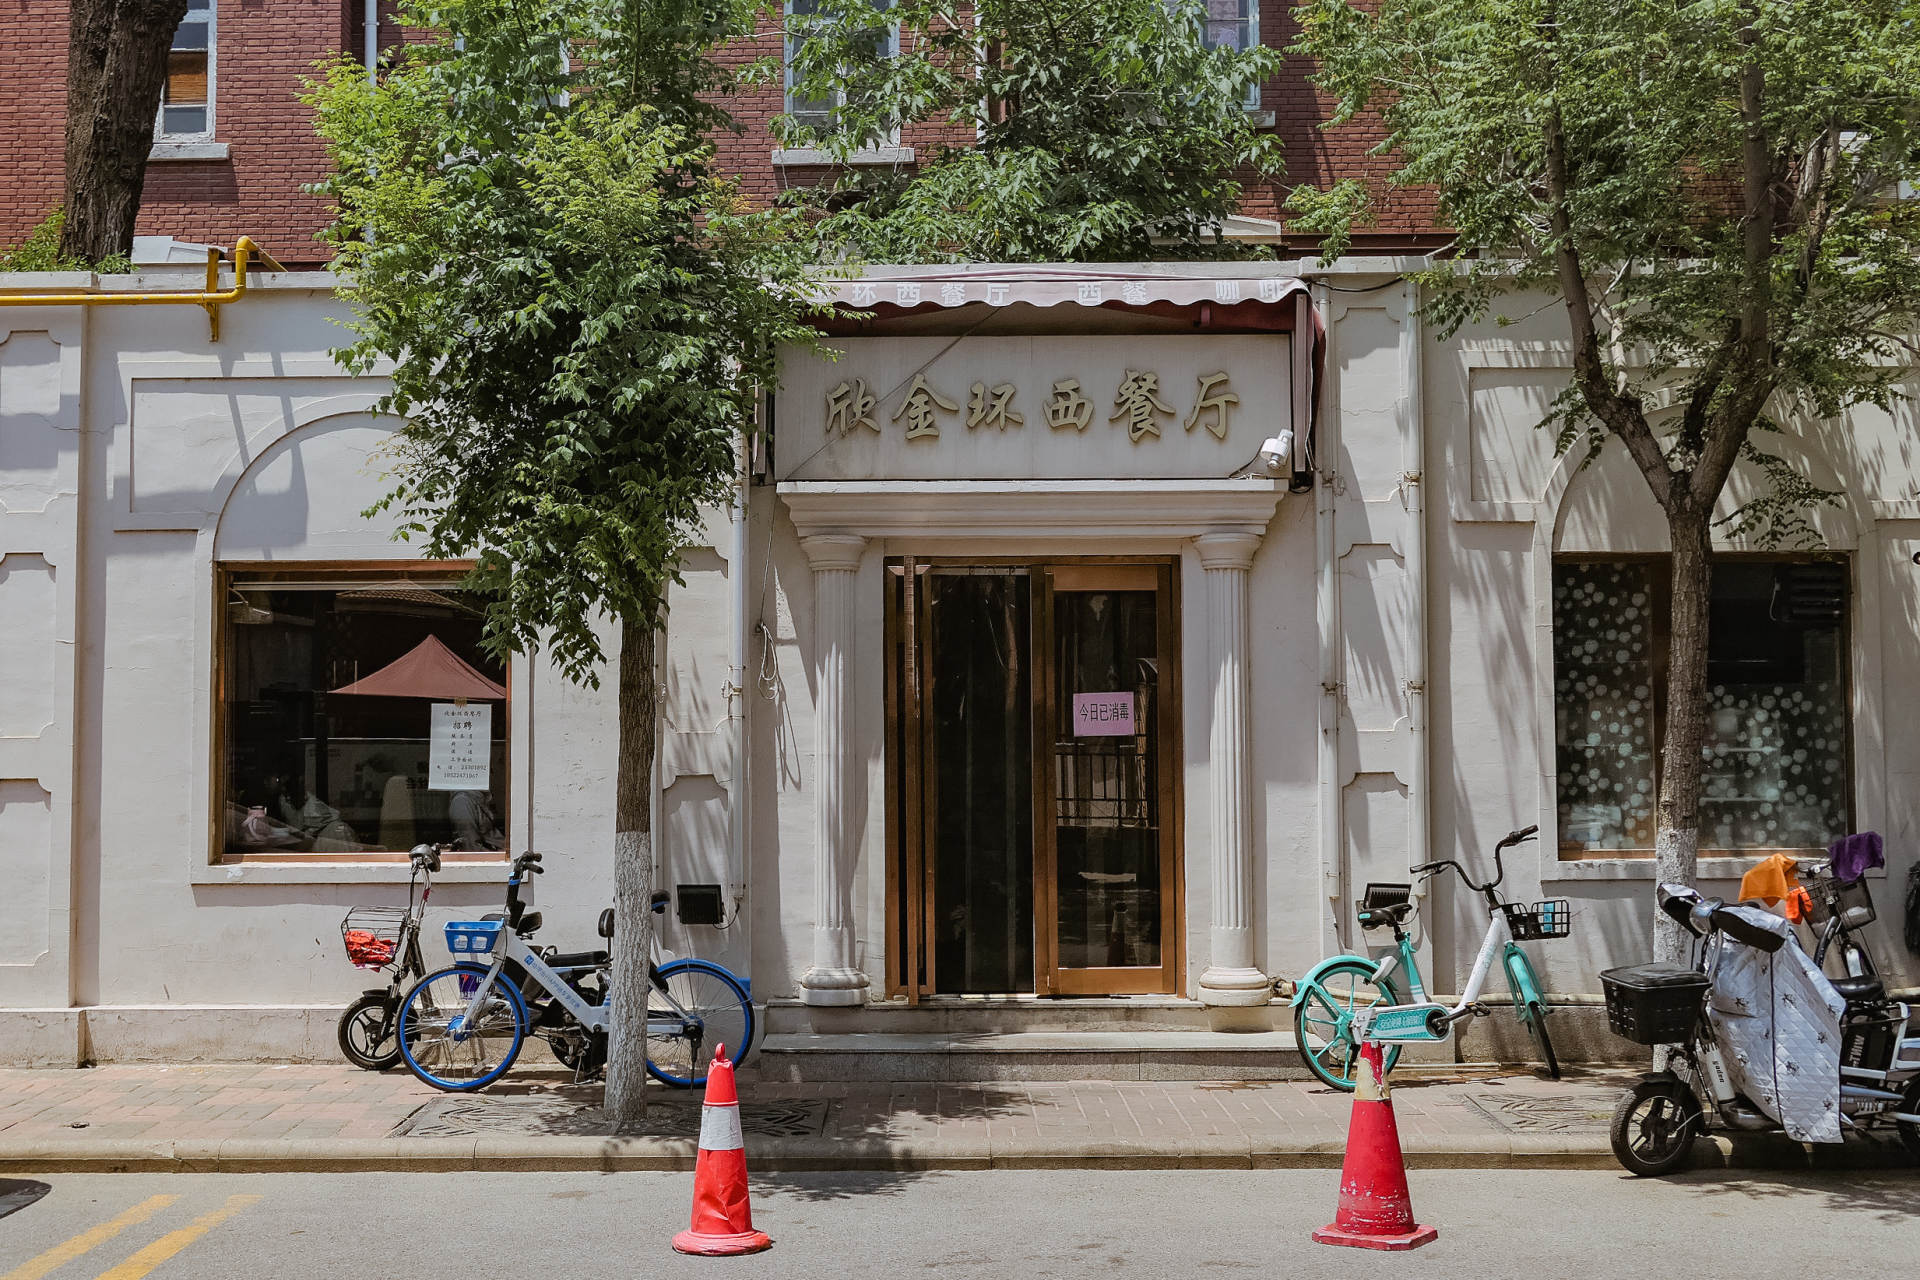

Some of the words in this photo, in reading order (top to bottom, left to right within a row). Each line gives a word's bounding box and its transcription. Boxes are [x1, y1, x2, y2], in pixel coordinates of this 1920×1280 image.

[1078, 282, 1147, 306] 西餐
[826, 369, 1239, 443] 欣金环西餐厅
[1080, 702, 1129, 722] 今日已消毒
